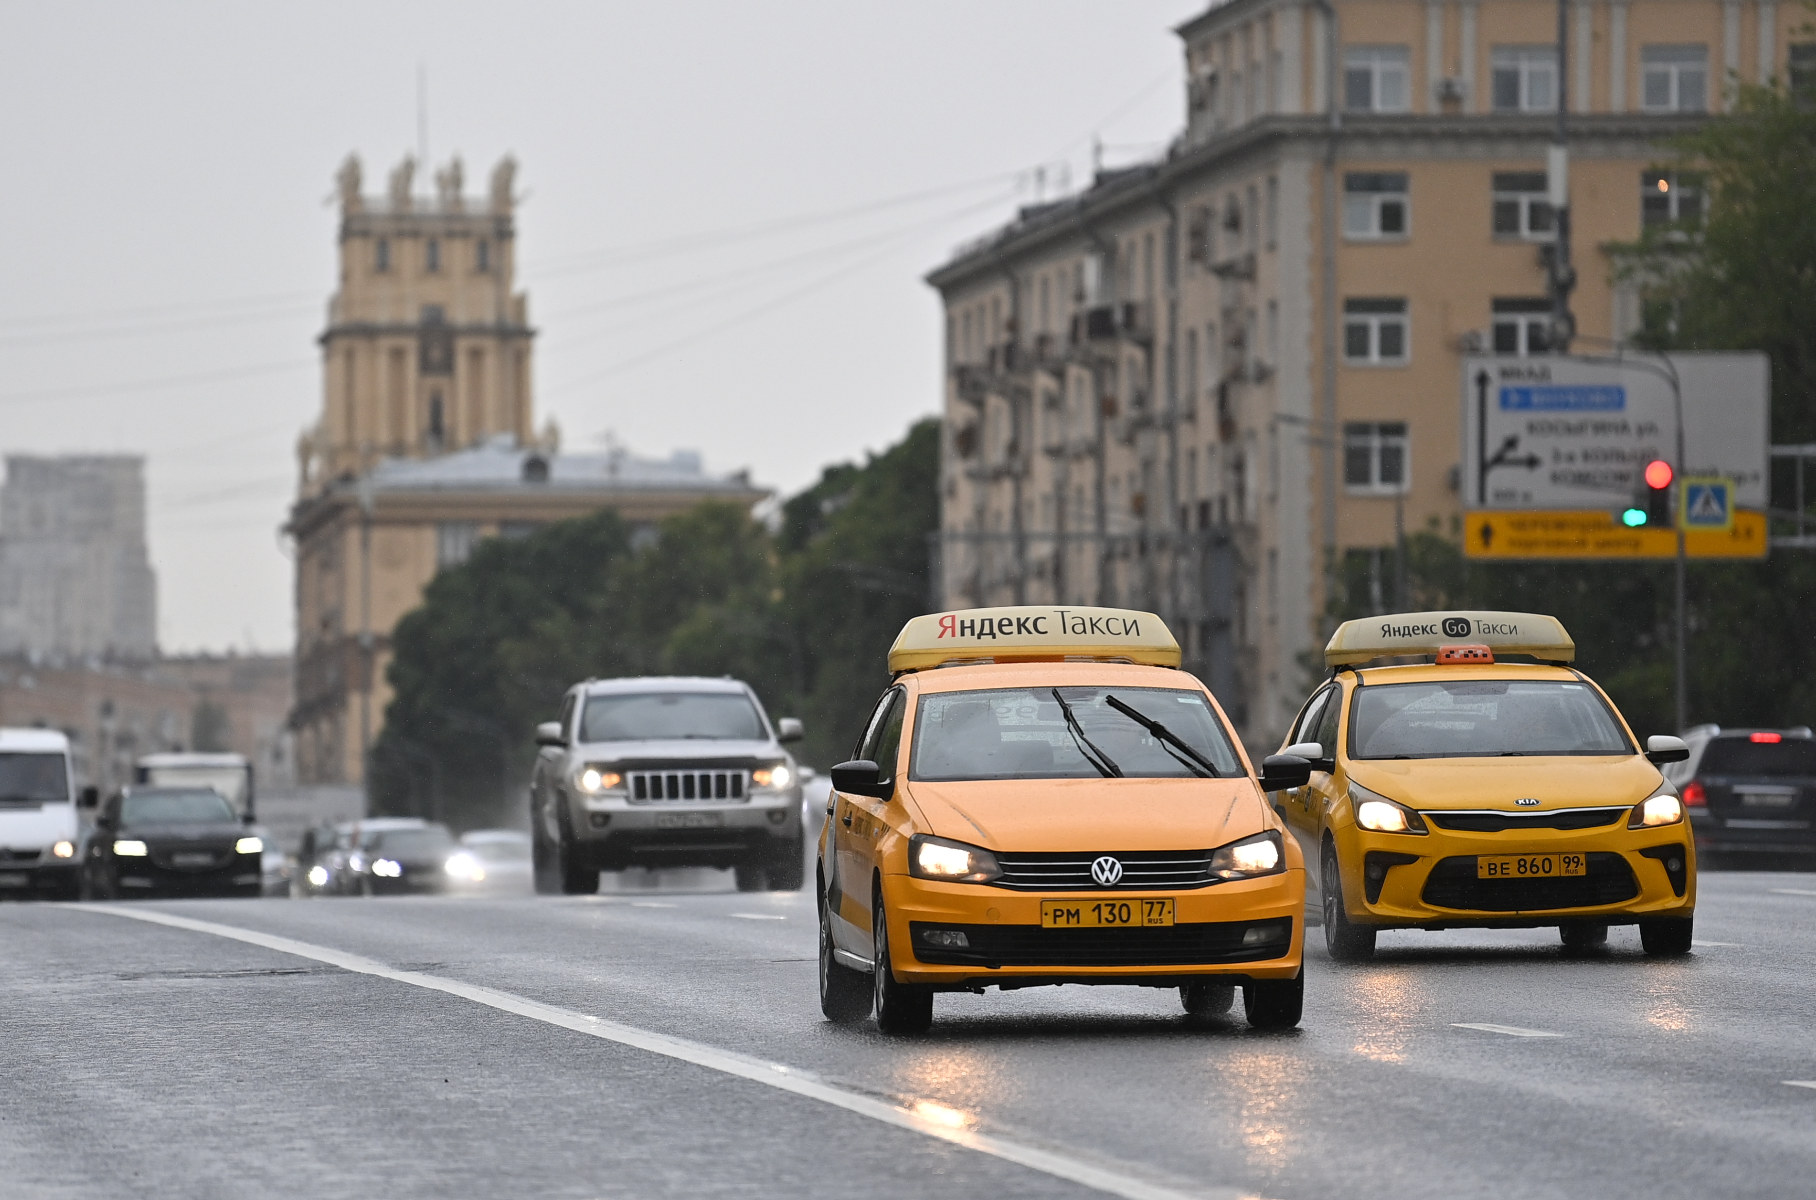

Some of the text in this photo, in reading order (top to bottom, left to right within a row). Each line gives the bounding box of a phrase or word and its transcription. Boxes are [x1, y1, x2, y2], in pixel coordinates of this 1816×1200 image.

[937, 610, 1140, 639] Яндекс Такси
[1381, 619, 1518, 638] Яндекс Go Такси
[1517, 857, 1552, 875] 860
[1562, 855, 1580, 869] 99
[1091, 903, 1131, 924] 130
[1145, 901, 1166, 917] 77
